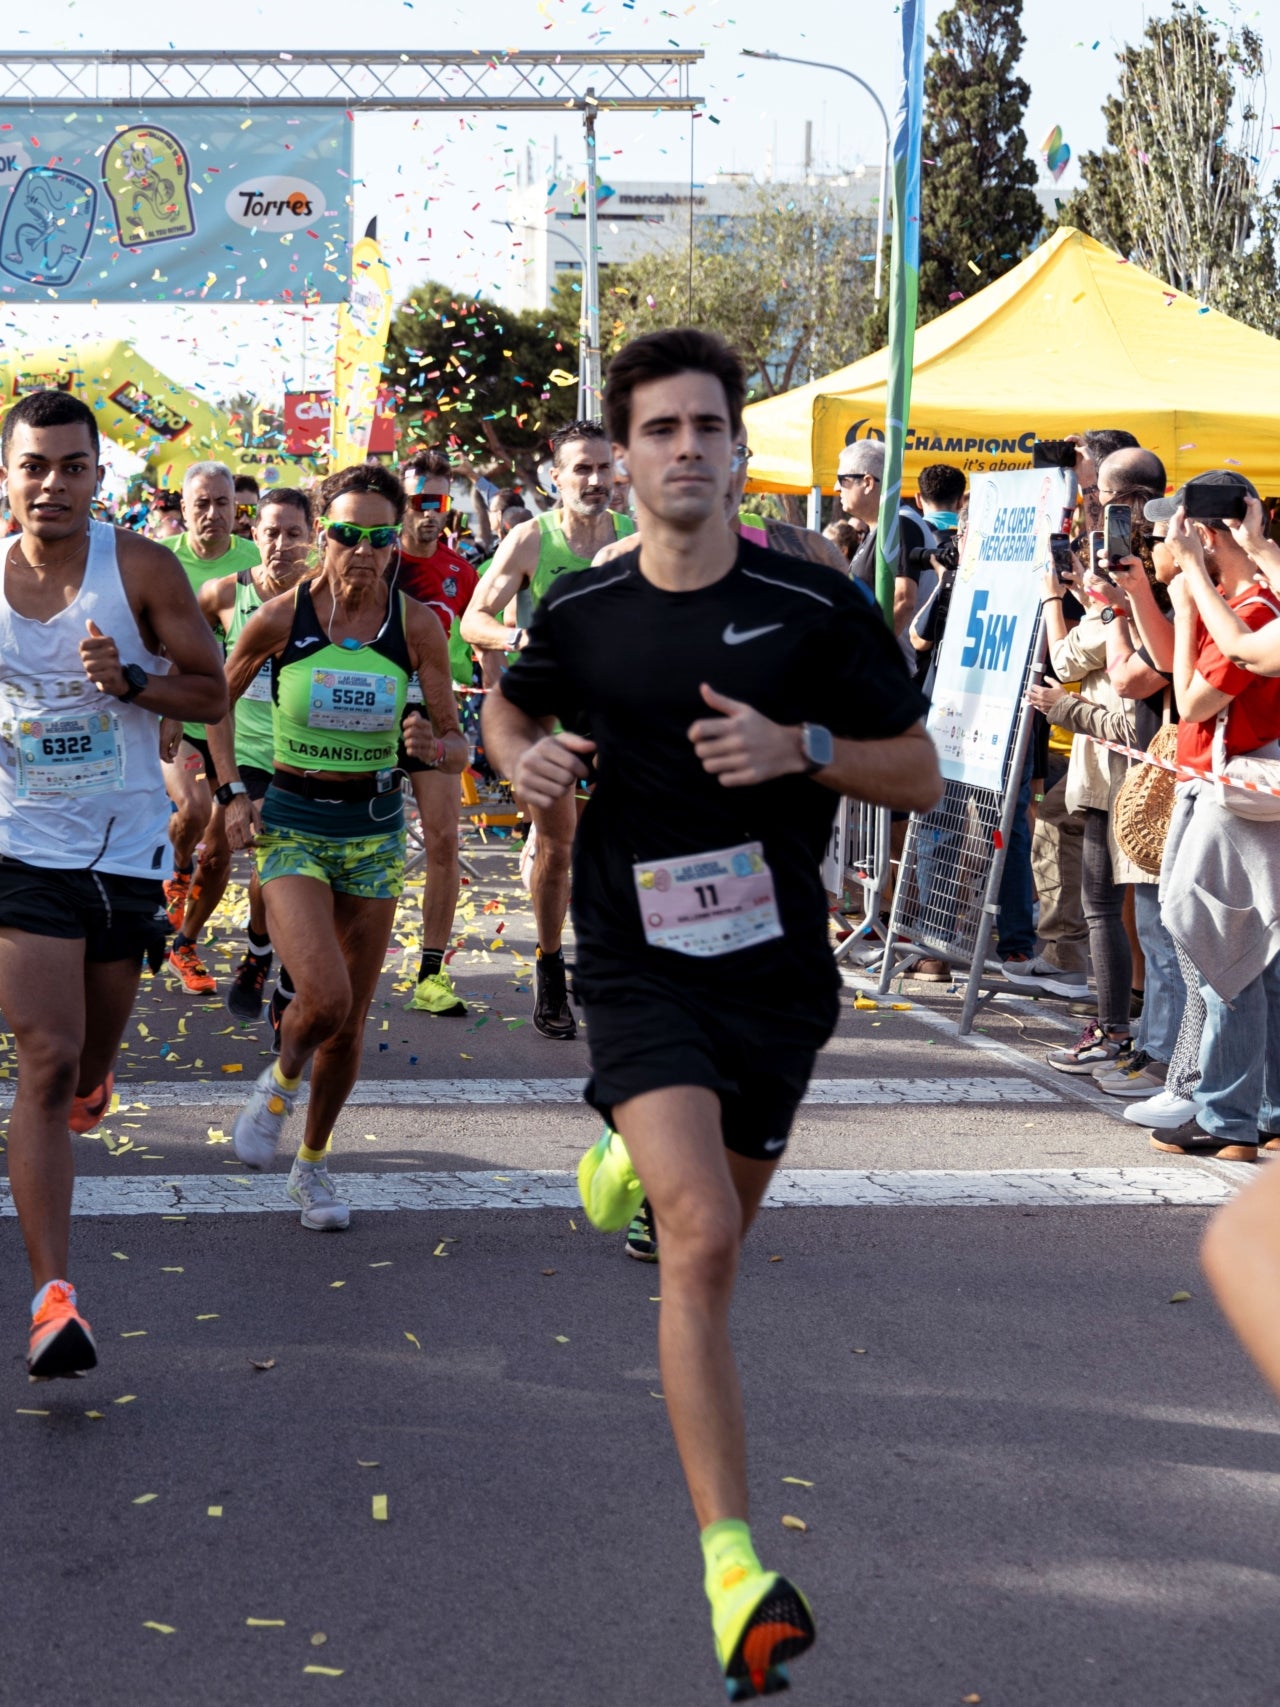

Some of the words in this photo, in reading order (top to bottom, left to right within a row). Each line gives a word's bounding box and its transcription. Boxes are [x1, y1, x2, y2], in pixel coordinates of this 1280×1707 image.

[239, 191, 313, 216] Torres
[963, 457, 985, 472] it's
[993, 508, 1009, 533] 6A
[1007, 506, 1036, 533] CURSA
[978, 535, 1037, 562] MERCABARNA
[332, 688, 376, 707] 5528
[42, 735, 92, 756] 6322
[288, 739, 394, 762] LASANSI.COM
[694, 884, 719, 909] 11
